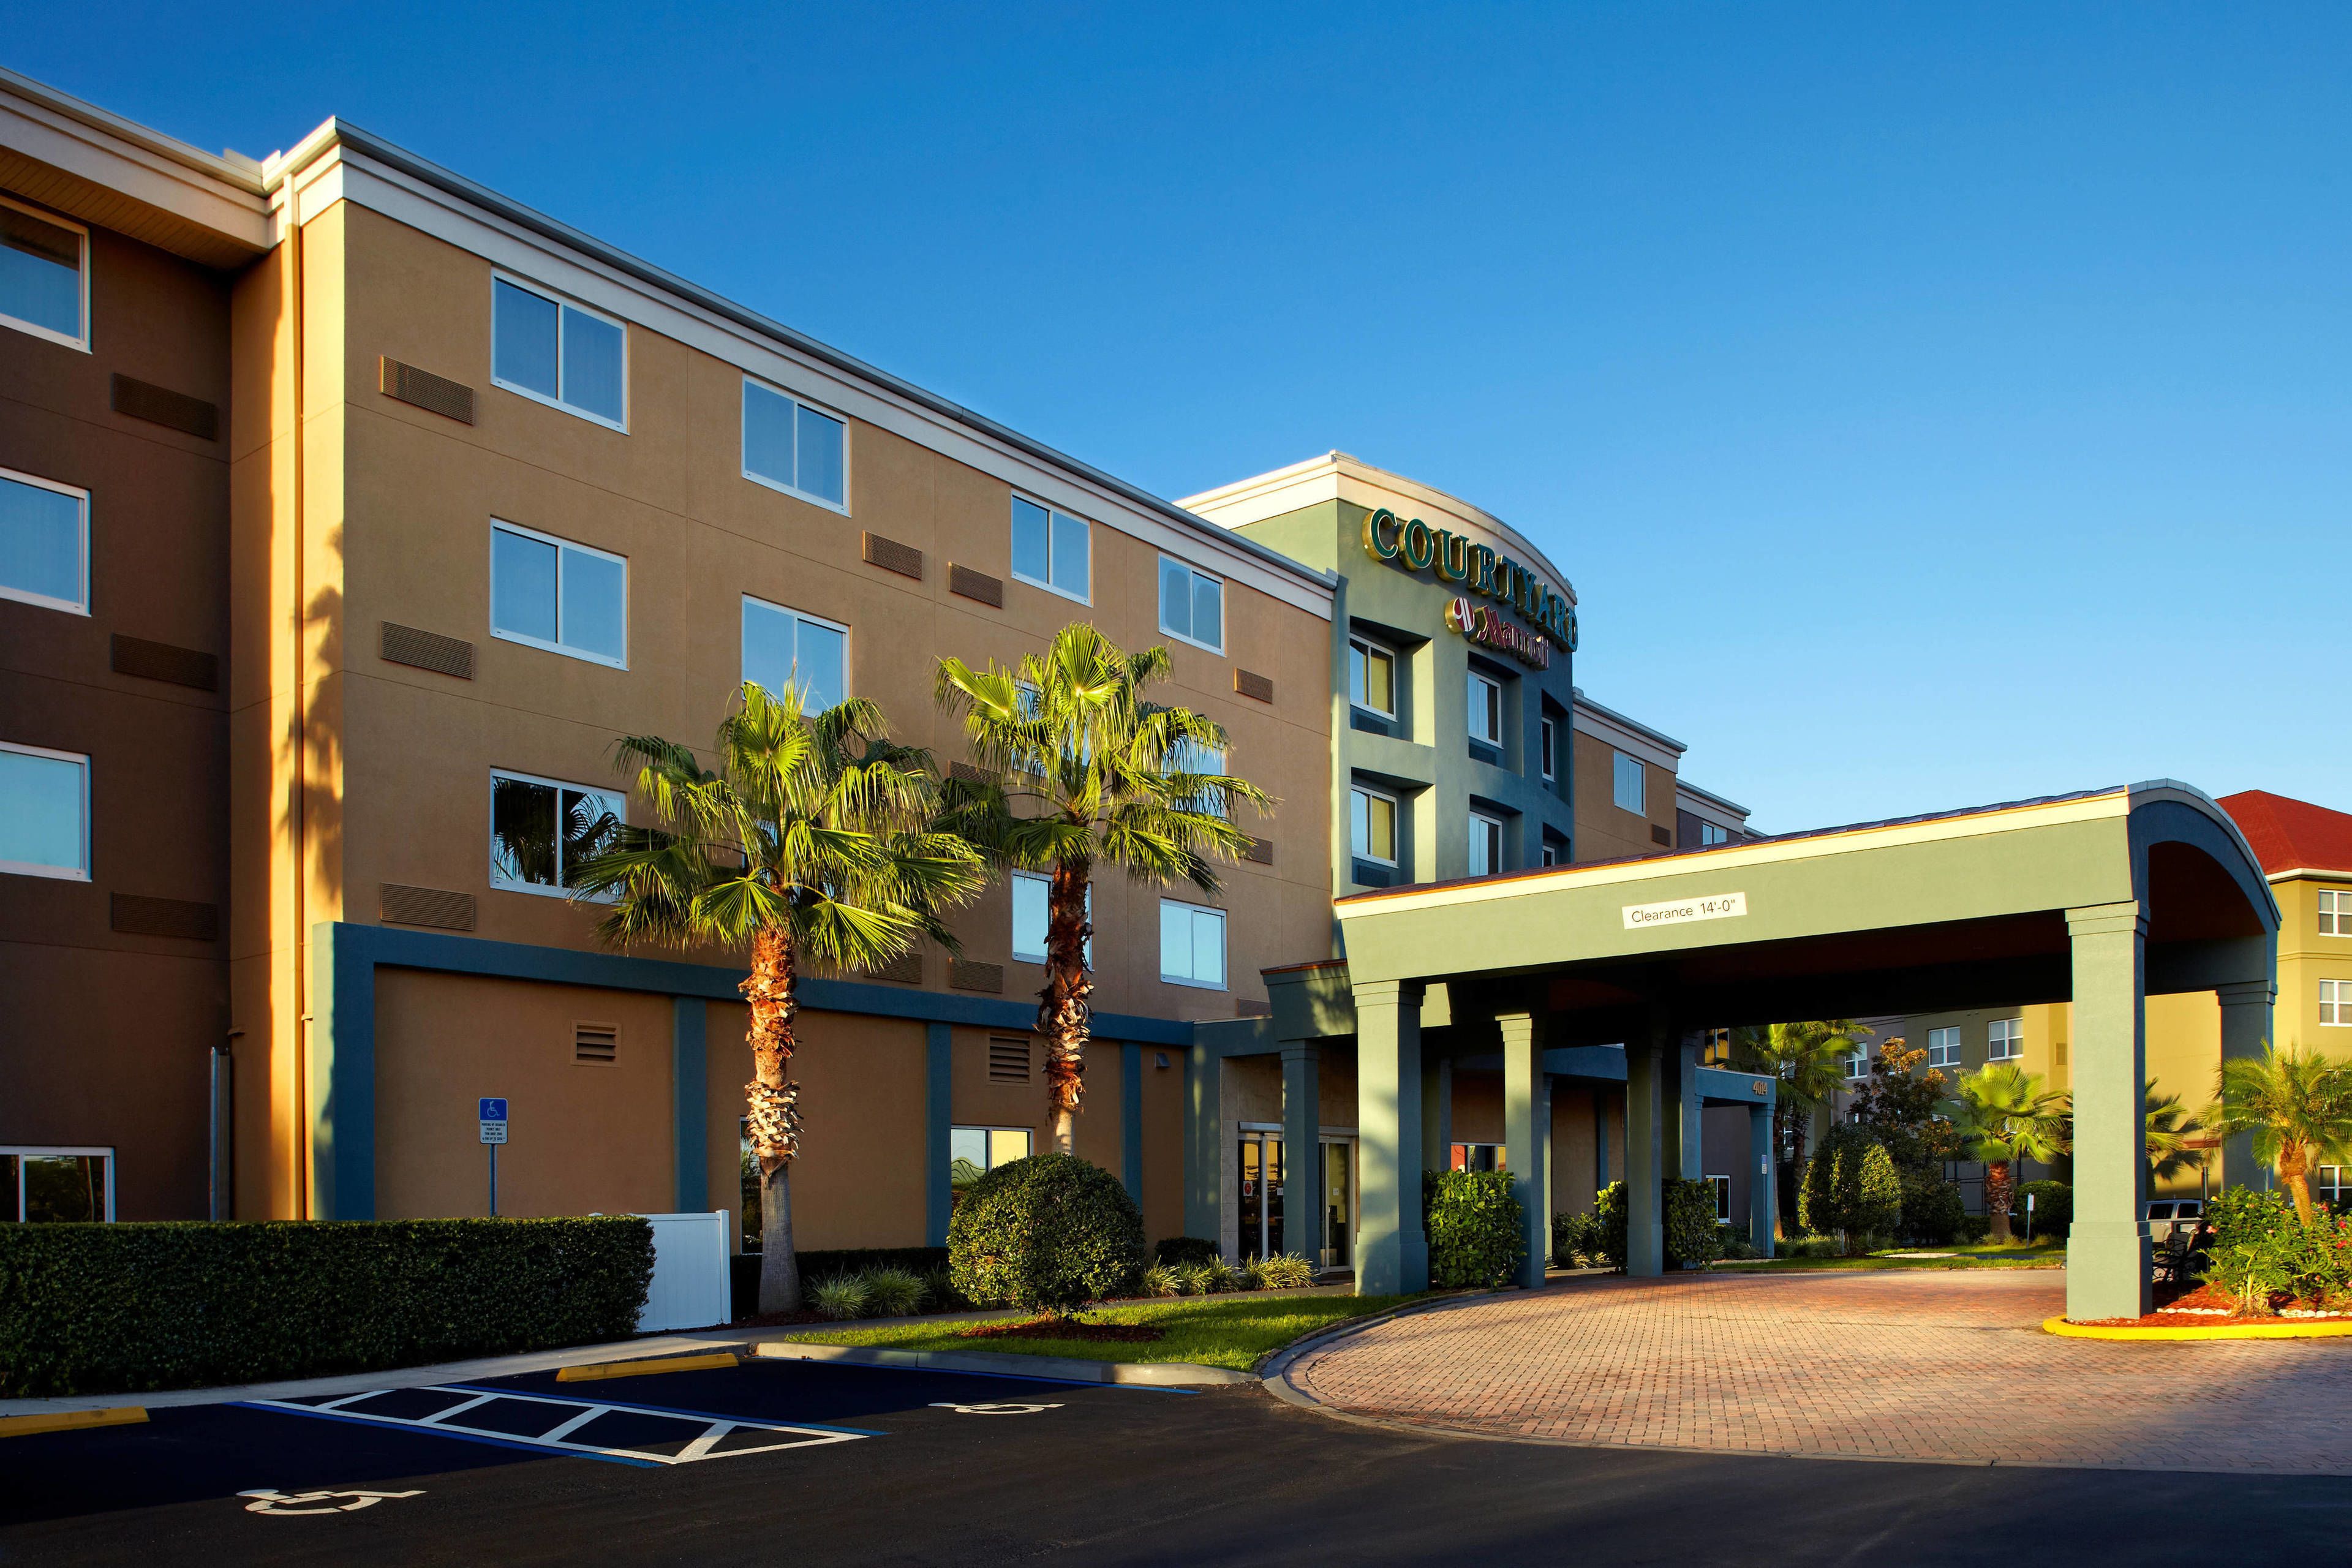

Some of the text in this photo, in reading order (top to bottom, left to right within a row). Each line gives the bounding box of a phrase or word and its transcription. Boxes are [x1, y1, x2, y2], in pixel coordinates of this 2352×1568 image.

[1365, 507, 1578, 652] COURTYARD
[1477, 605, 1549, 669] Marriott
[1632, 899, 1735, 922] Clearance 14'-0"
[1753, 1080, 1768, 1095] 4014
